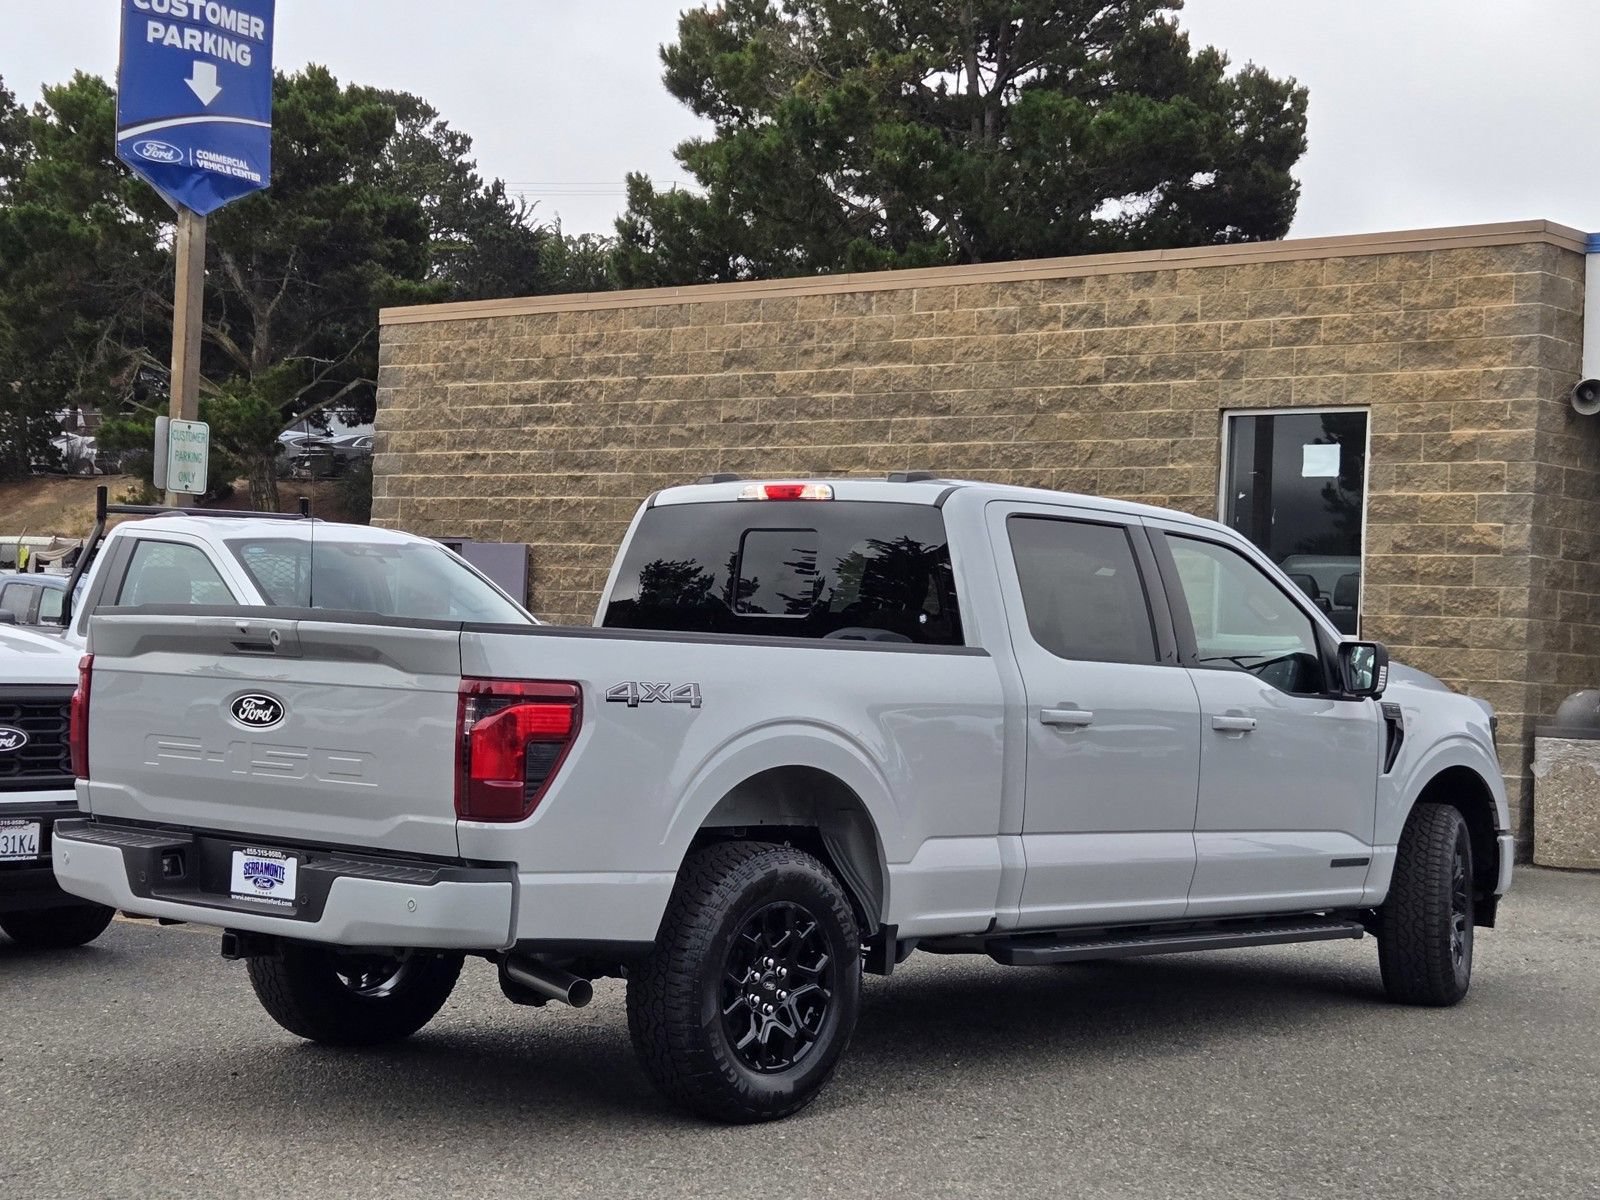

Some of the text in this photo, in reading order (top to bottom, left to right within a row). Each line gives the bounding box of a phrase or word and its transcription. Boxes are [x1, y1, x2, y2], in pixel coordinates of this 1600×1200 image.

[147, 20, 252, 67] PARKING
[142, 142, 174, 161] Ford
[196, 149, 249, 170] COMMERCIAL
[196, 159, 261, 182] VEHICLE CENTER
[171, 430, 206, 444] CUSTOMER
[175, 449, 203, 463] PARKING
[178, 471, 196, 484] ONLY
[238, 697, 274, 722] Ford
[244, 862, 285, 880] SERRAMONTE
